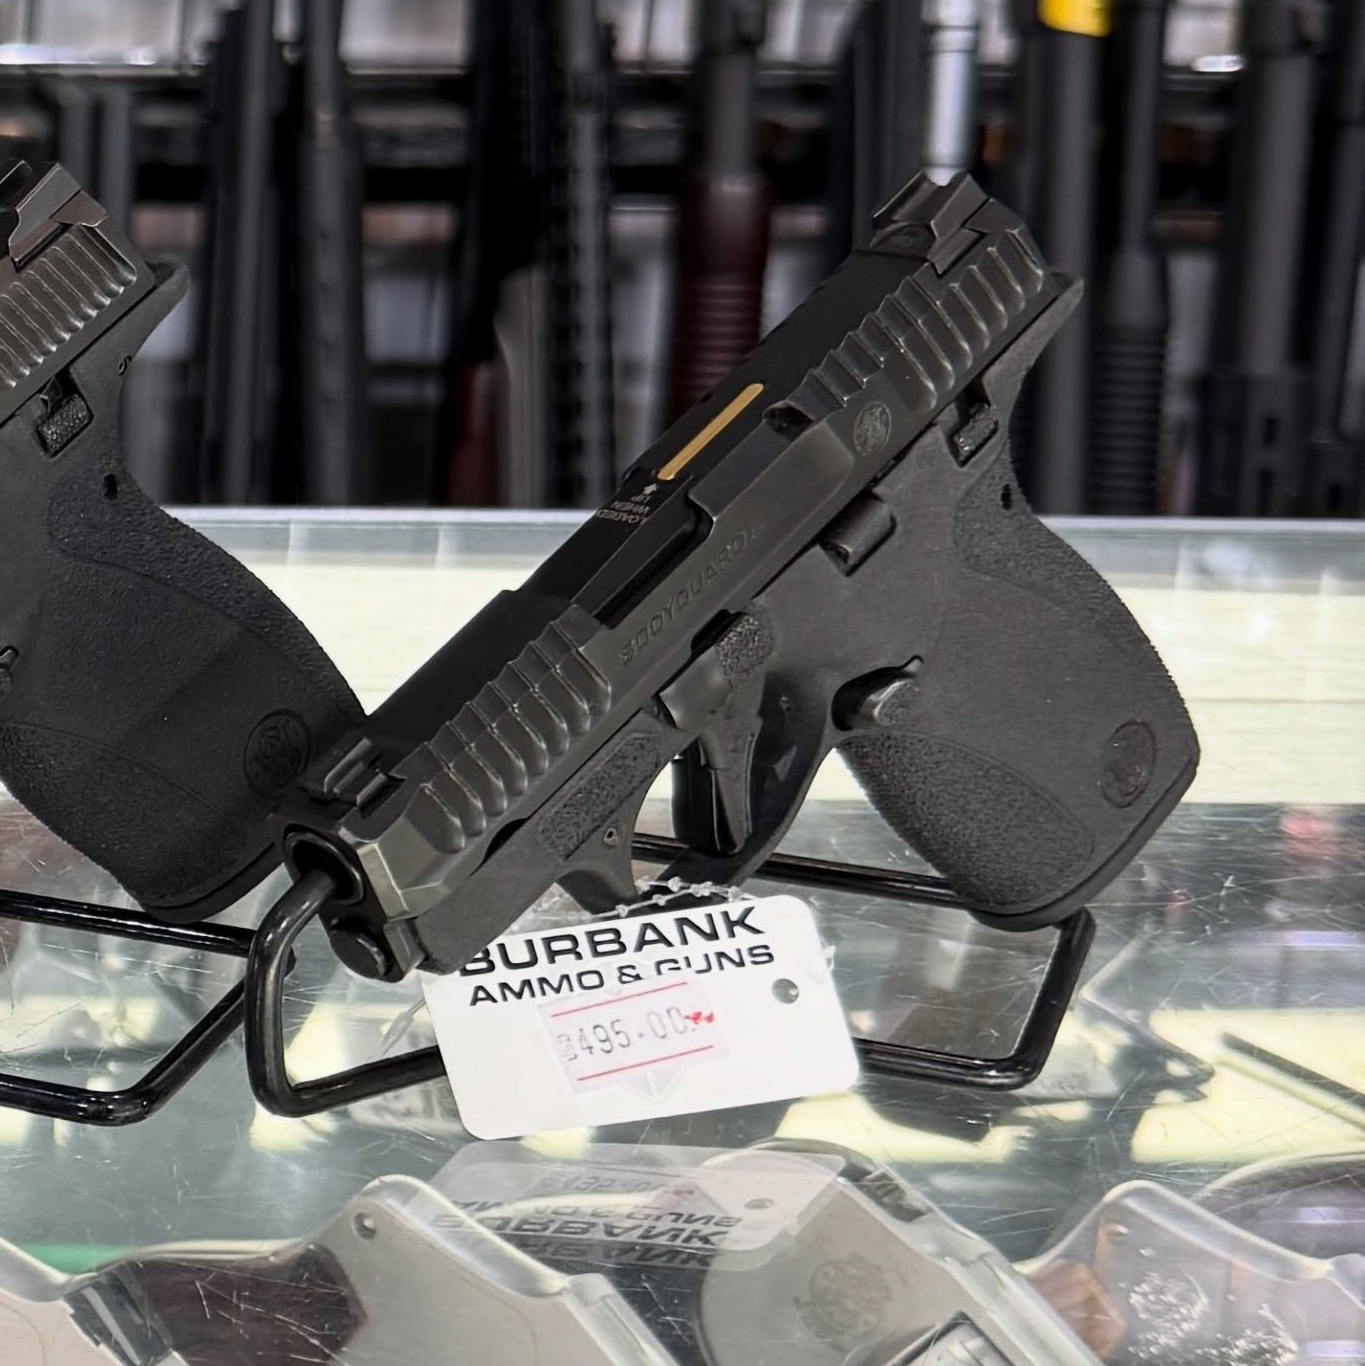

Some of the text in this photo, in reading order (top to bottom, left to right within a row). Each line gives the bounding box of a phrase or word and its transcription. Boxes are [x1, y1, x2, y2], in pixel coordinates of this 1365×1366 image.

[458, 905, 766, 978] BURBANK
[468, 969, 606, 1007] AMMO
[616, 962, 643, 986] &
